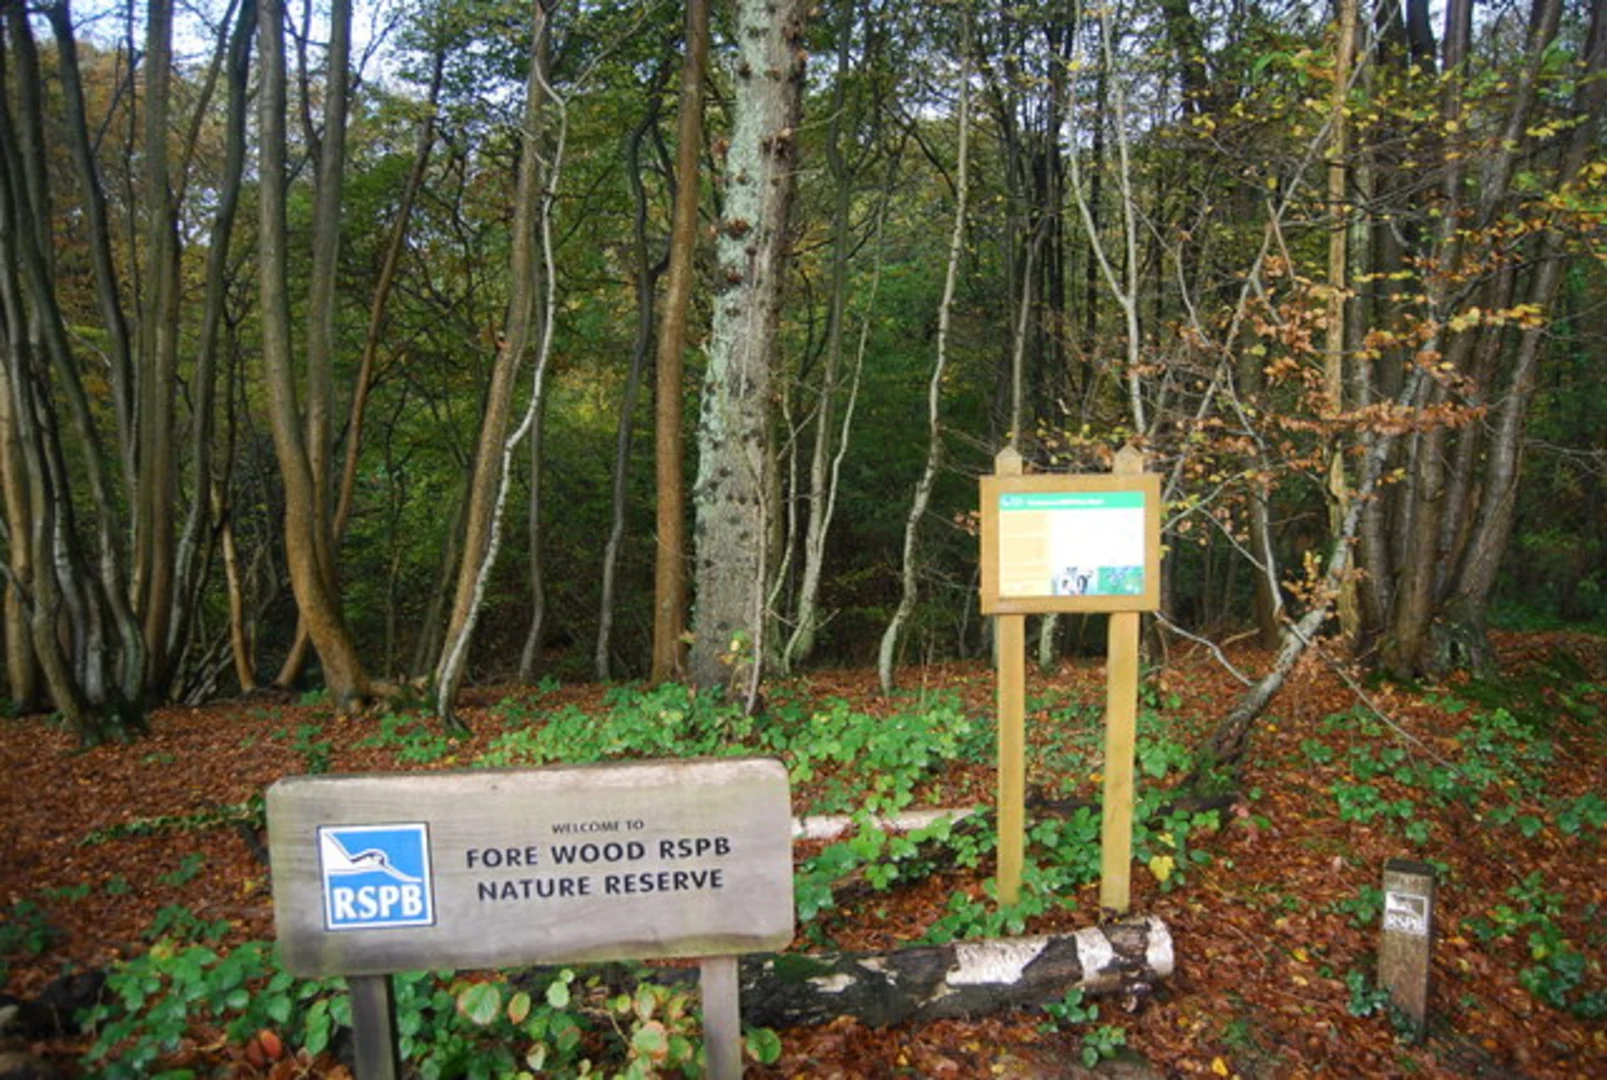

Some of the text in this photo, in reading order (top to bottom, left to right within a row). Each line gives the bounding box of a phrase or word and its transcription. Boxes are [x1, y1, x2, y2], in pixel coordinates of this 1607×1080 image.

[552, 818, 645, 835] WELCOME TO
[466, 836, 732, 870] FORE WOOD RSPB
[478, 868, 724, 901] NATURE RESERVE
[333, 883, 423, 920] RSPB
